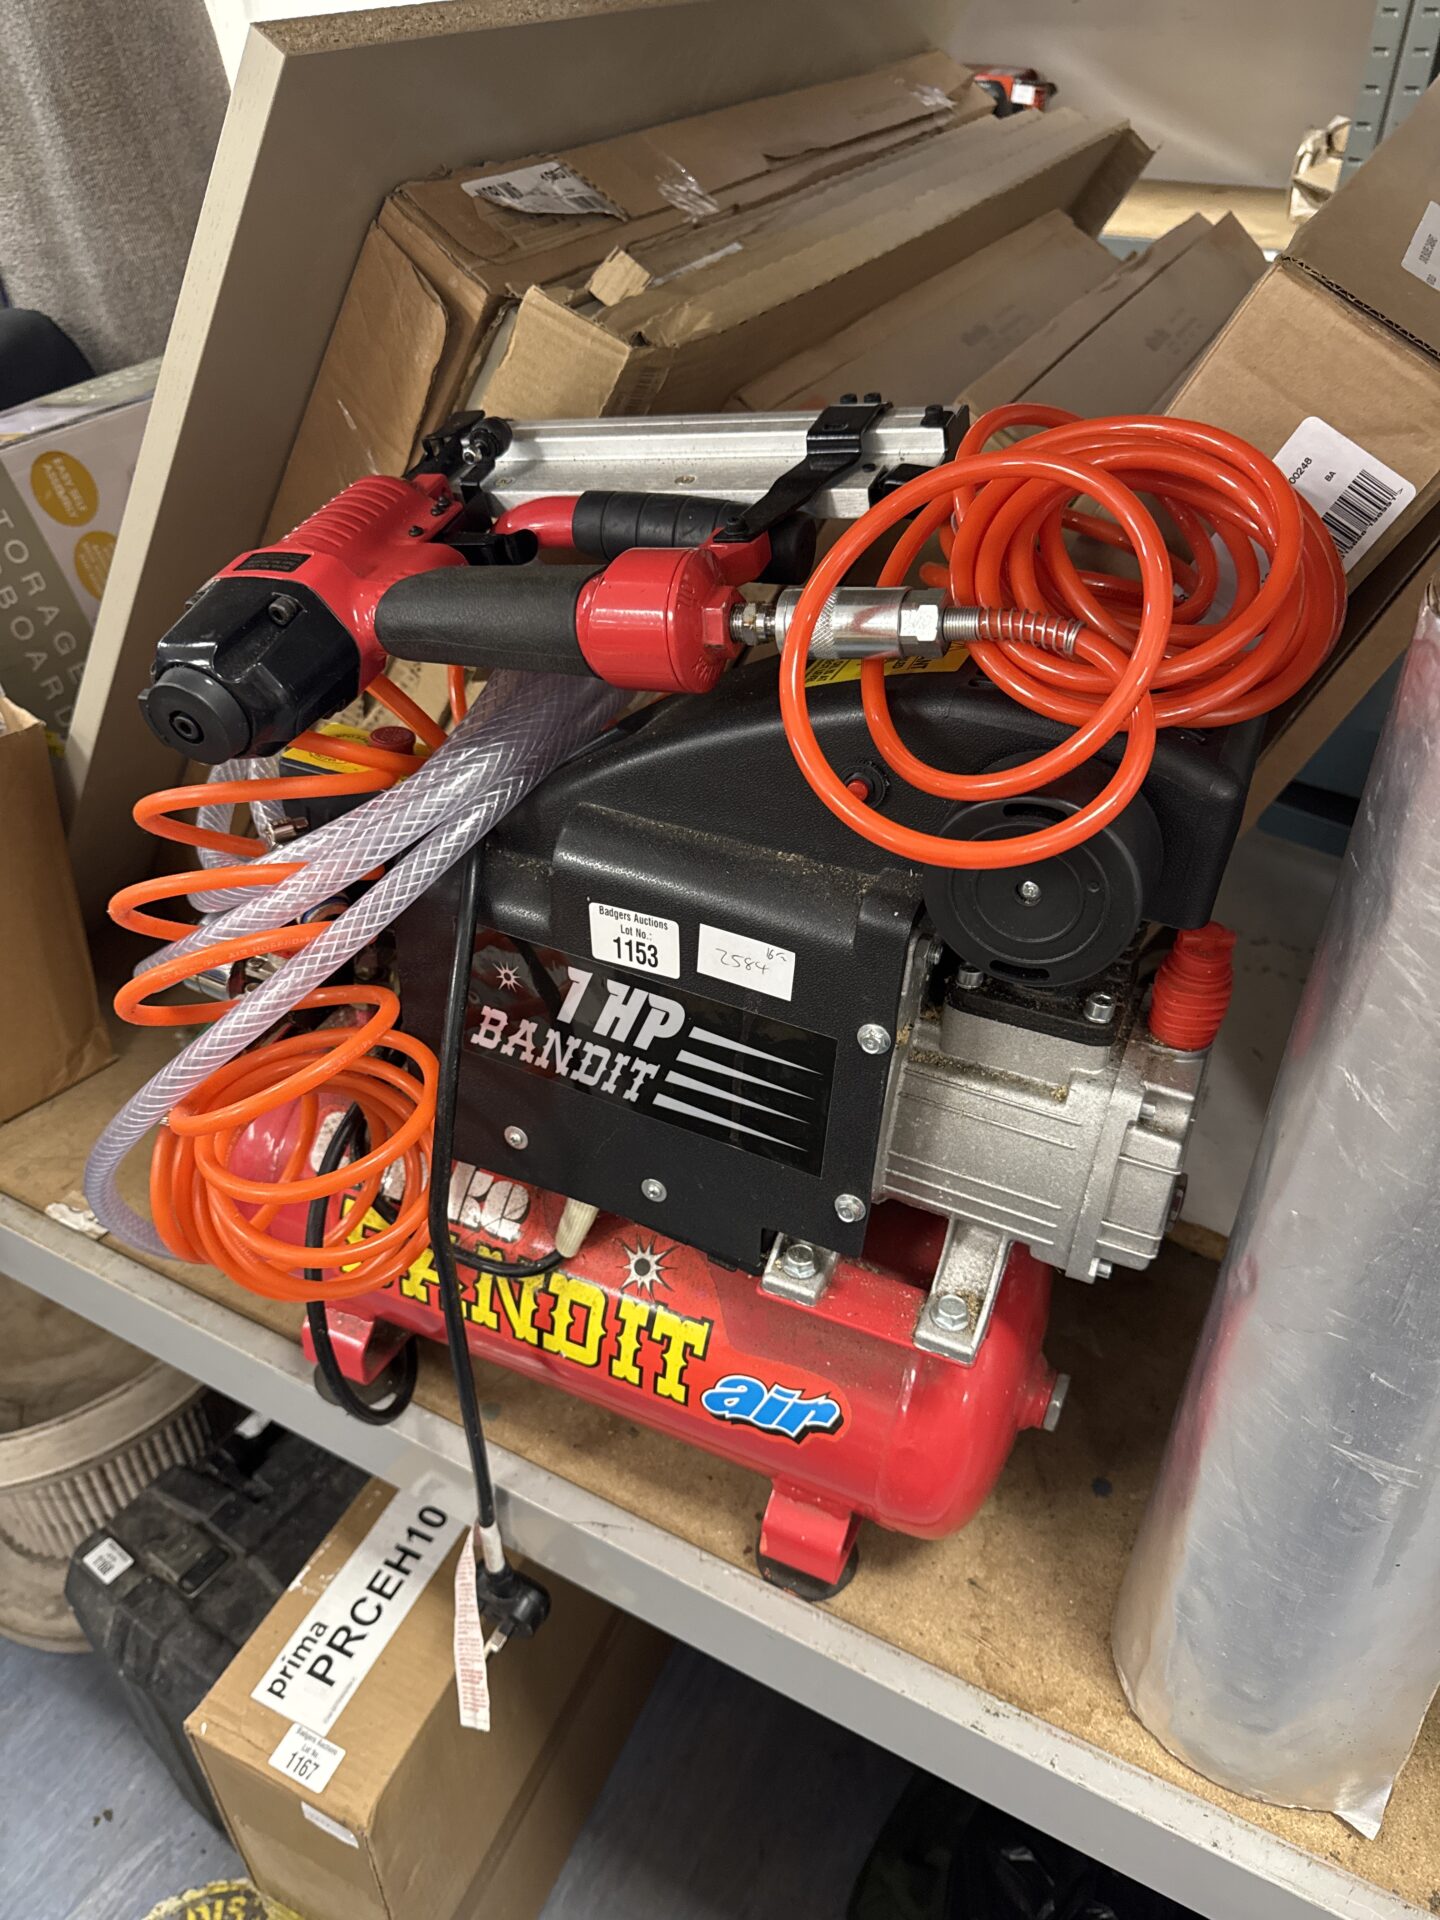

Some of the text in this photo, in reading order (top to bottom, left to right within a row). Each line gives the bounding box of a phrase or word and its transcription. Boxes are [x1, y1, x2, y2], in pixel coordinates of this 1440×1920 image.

[1324, 471, 1337, 482] BA
[599, 906, 668, 931] Badgers Auctions
[620, 925, 633, 936] Lot
[613, 937, 659, 968] 1153
[715, 948, 769, 975] 2584
[557, 966, 685, 1050] 1 HP
[471, 1005, 660, 1103] BANDIT
[701, 1374, 844, 1443] air
[306, 1505, 448, 1687] PRCEH10
[267, 1620, 329, 1700] prima
[286, 1751, 320, 1780] 1167
